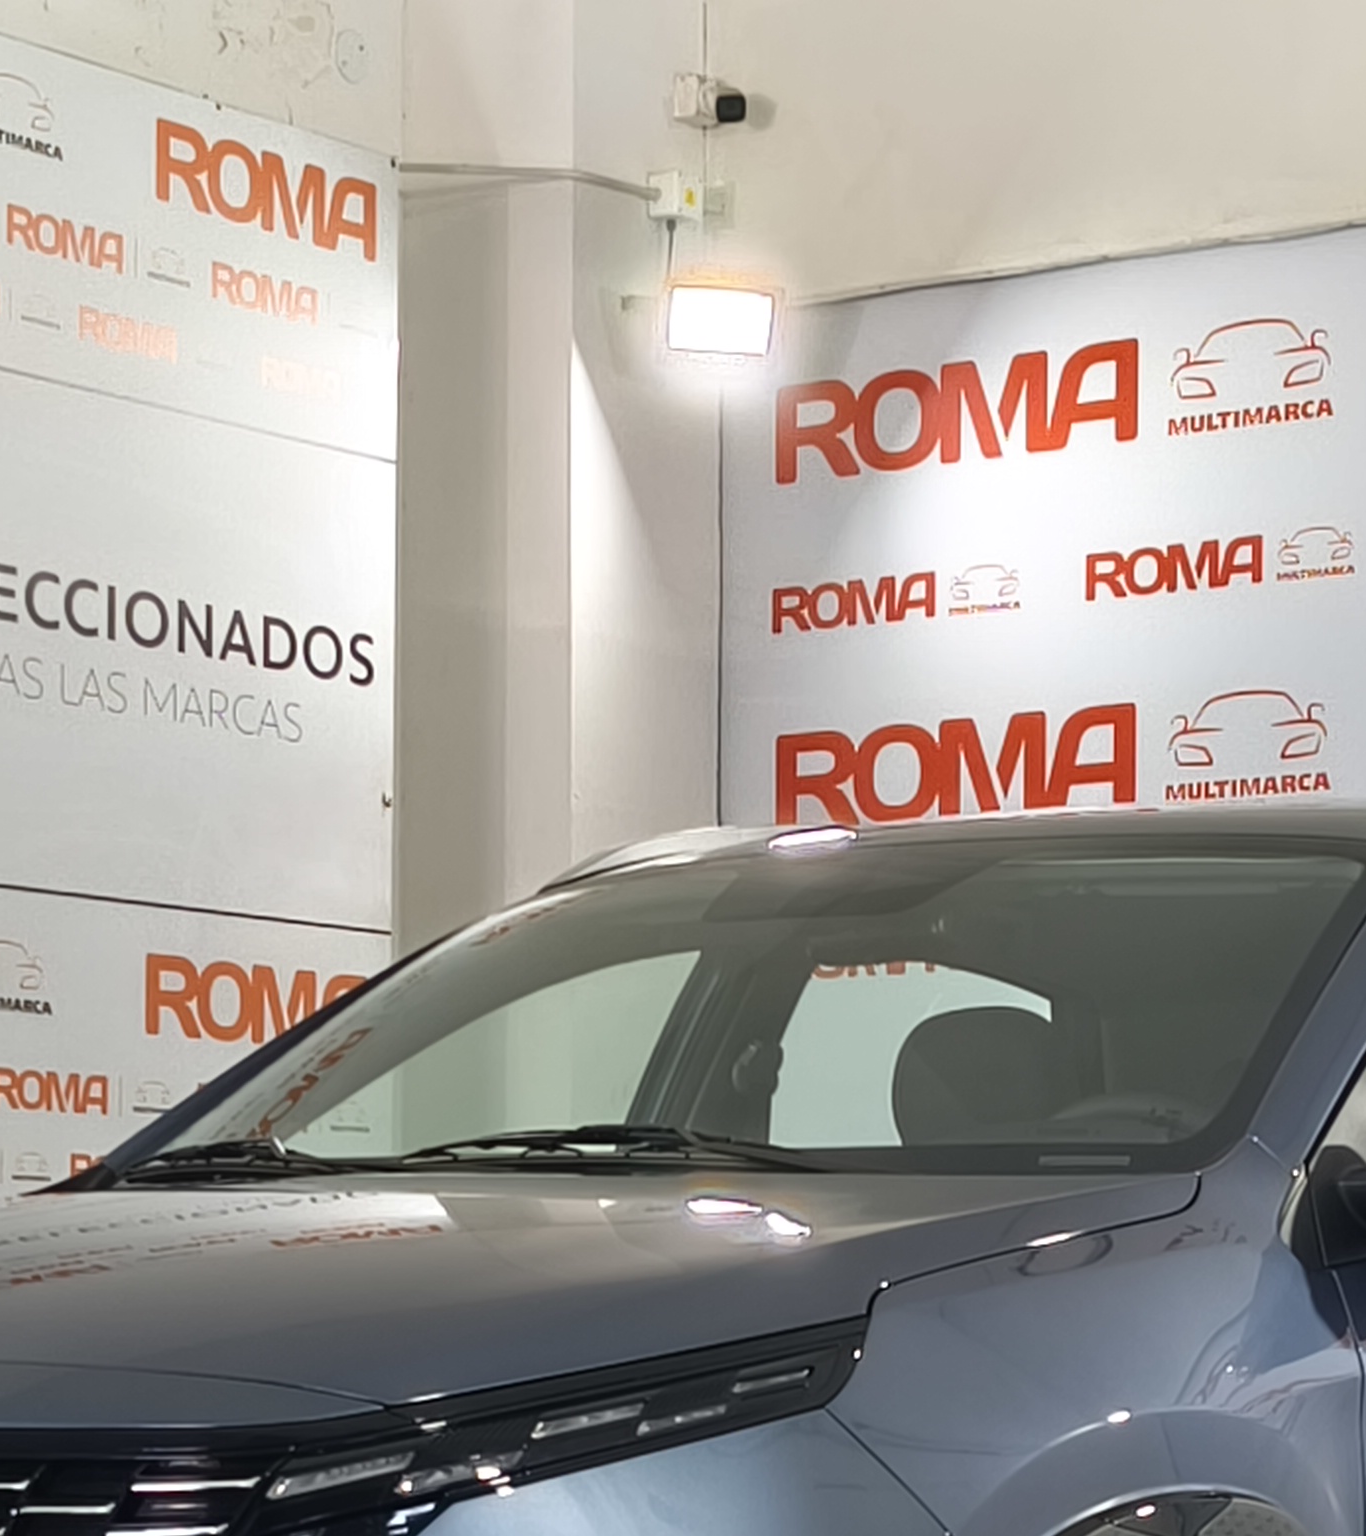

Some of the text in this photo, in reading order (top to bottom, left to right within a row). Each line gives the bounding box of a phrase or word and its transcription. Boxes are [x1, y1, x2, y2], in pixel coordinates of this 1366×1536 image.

[156, 118, 377, 263] ROMA
[7, 204, 123, 274] ROMA
[212, 261, 318, 326] ROMA
[775, 338, 1138, 485] ROMA
[1167, 399, 1334, 436] MULTIMARCA
[772, 571, 936, 634] ROMA
[1085, 535, 1263, 601] ROMA
[59, 662, 129, 714] LAS
[143, 677, 303, 744] MARCAS
[775, 702, 1136, 824] ROMA
[1165, 773, 1331, 801] MULTIMARCA
[145, 953, 370, 1044] ROM
